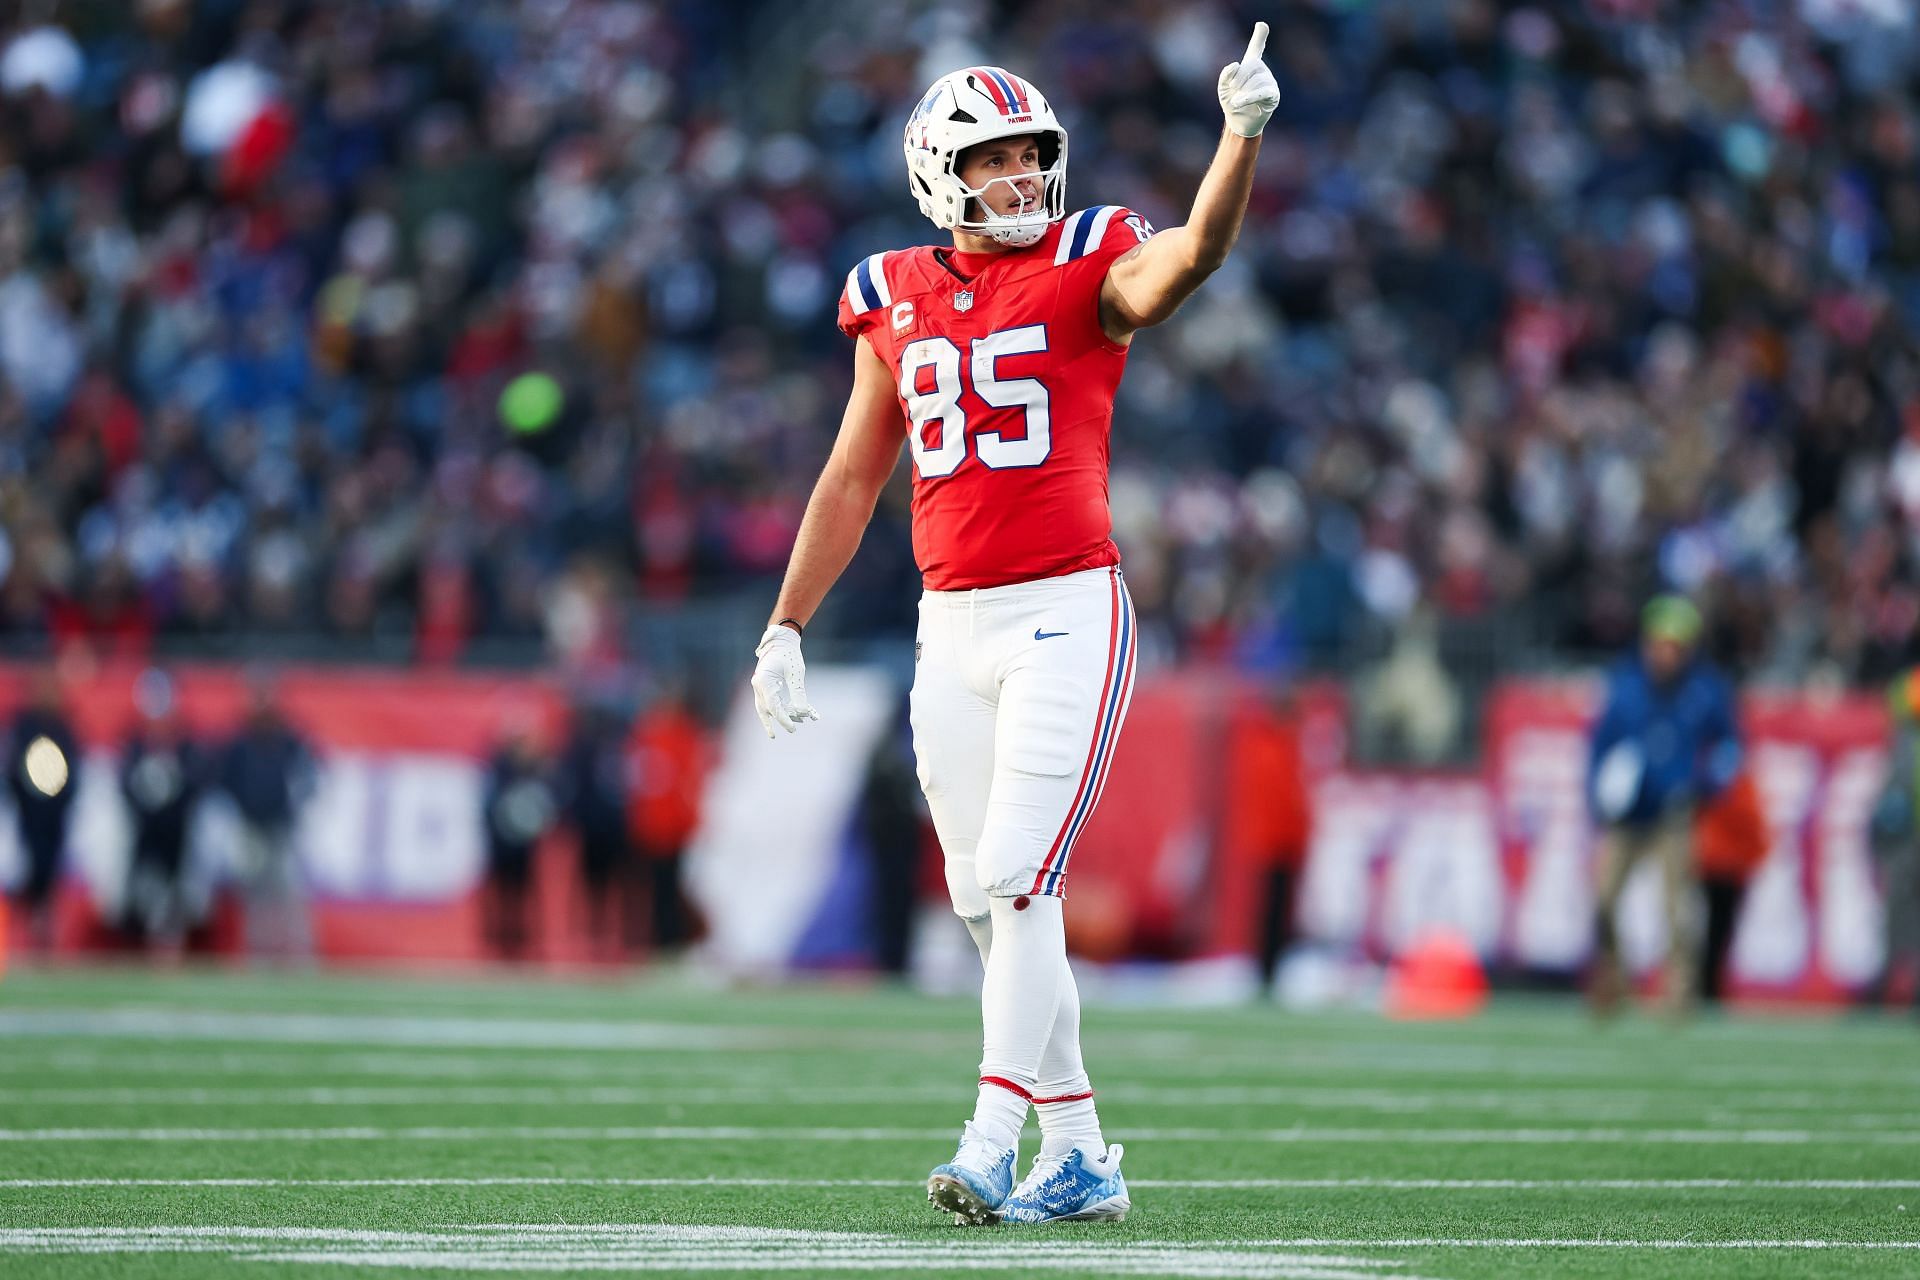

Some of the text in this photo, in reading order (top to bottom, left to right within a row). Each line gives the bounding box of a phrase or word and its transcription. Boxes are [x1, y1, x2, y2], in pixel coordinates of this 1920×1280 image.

[1007, 115, 1033, 124] PATRIOTS
[892, 297, 914, 331] C
[900, 323, 1051, 479] 85
